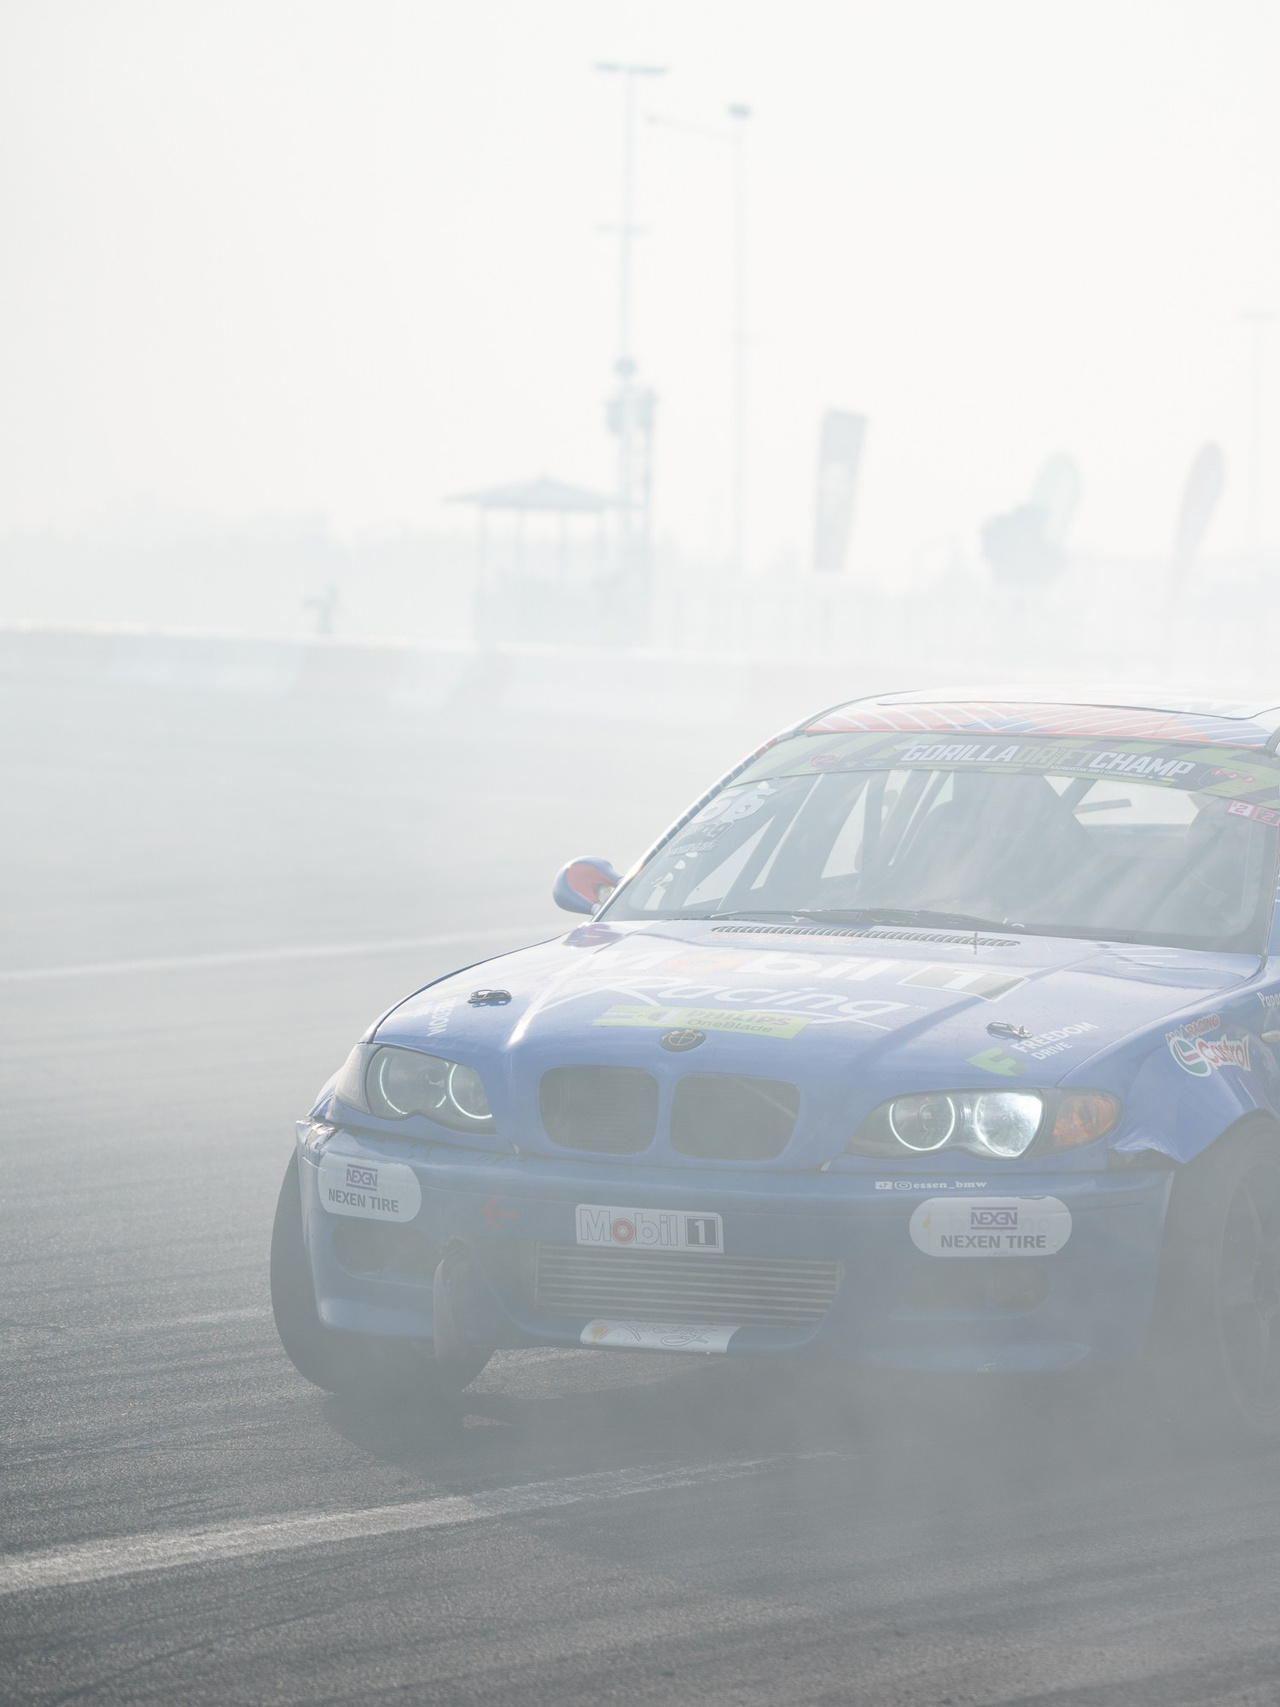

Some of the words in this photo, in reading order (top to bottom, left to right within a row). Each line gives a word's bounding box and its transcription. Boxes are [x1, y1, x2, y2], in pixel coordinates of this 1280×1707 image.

[687, 1010, 792, 1026] PHILIPS
[688, 1019, 774, 1033] OneBlade
[1010, 1021, 1100, 1053] FREEDOM
[1030, 1041, 1074, 1060] DRIVE
[1197, 1037, 1250, 1071] Castrol
[346, 1168, 378, 1187] NEXEN
[913, 1180, 988, 1190] essen_bmw
[328, 1188, 366, 1208] NEXEN
[369, 1196, 399, 1213] TIRE
[579, 1208, 679, 1246] Mobil
[970, 1211, 1018, 1226] NEXEN
[940, 1235, 1001, 1249] NEXEN
[1005, 1235, 1046, 1249] TIRE
